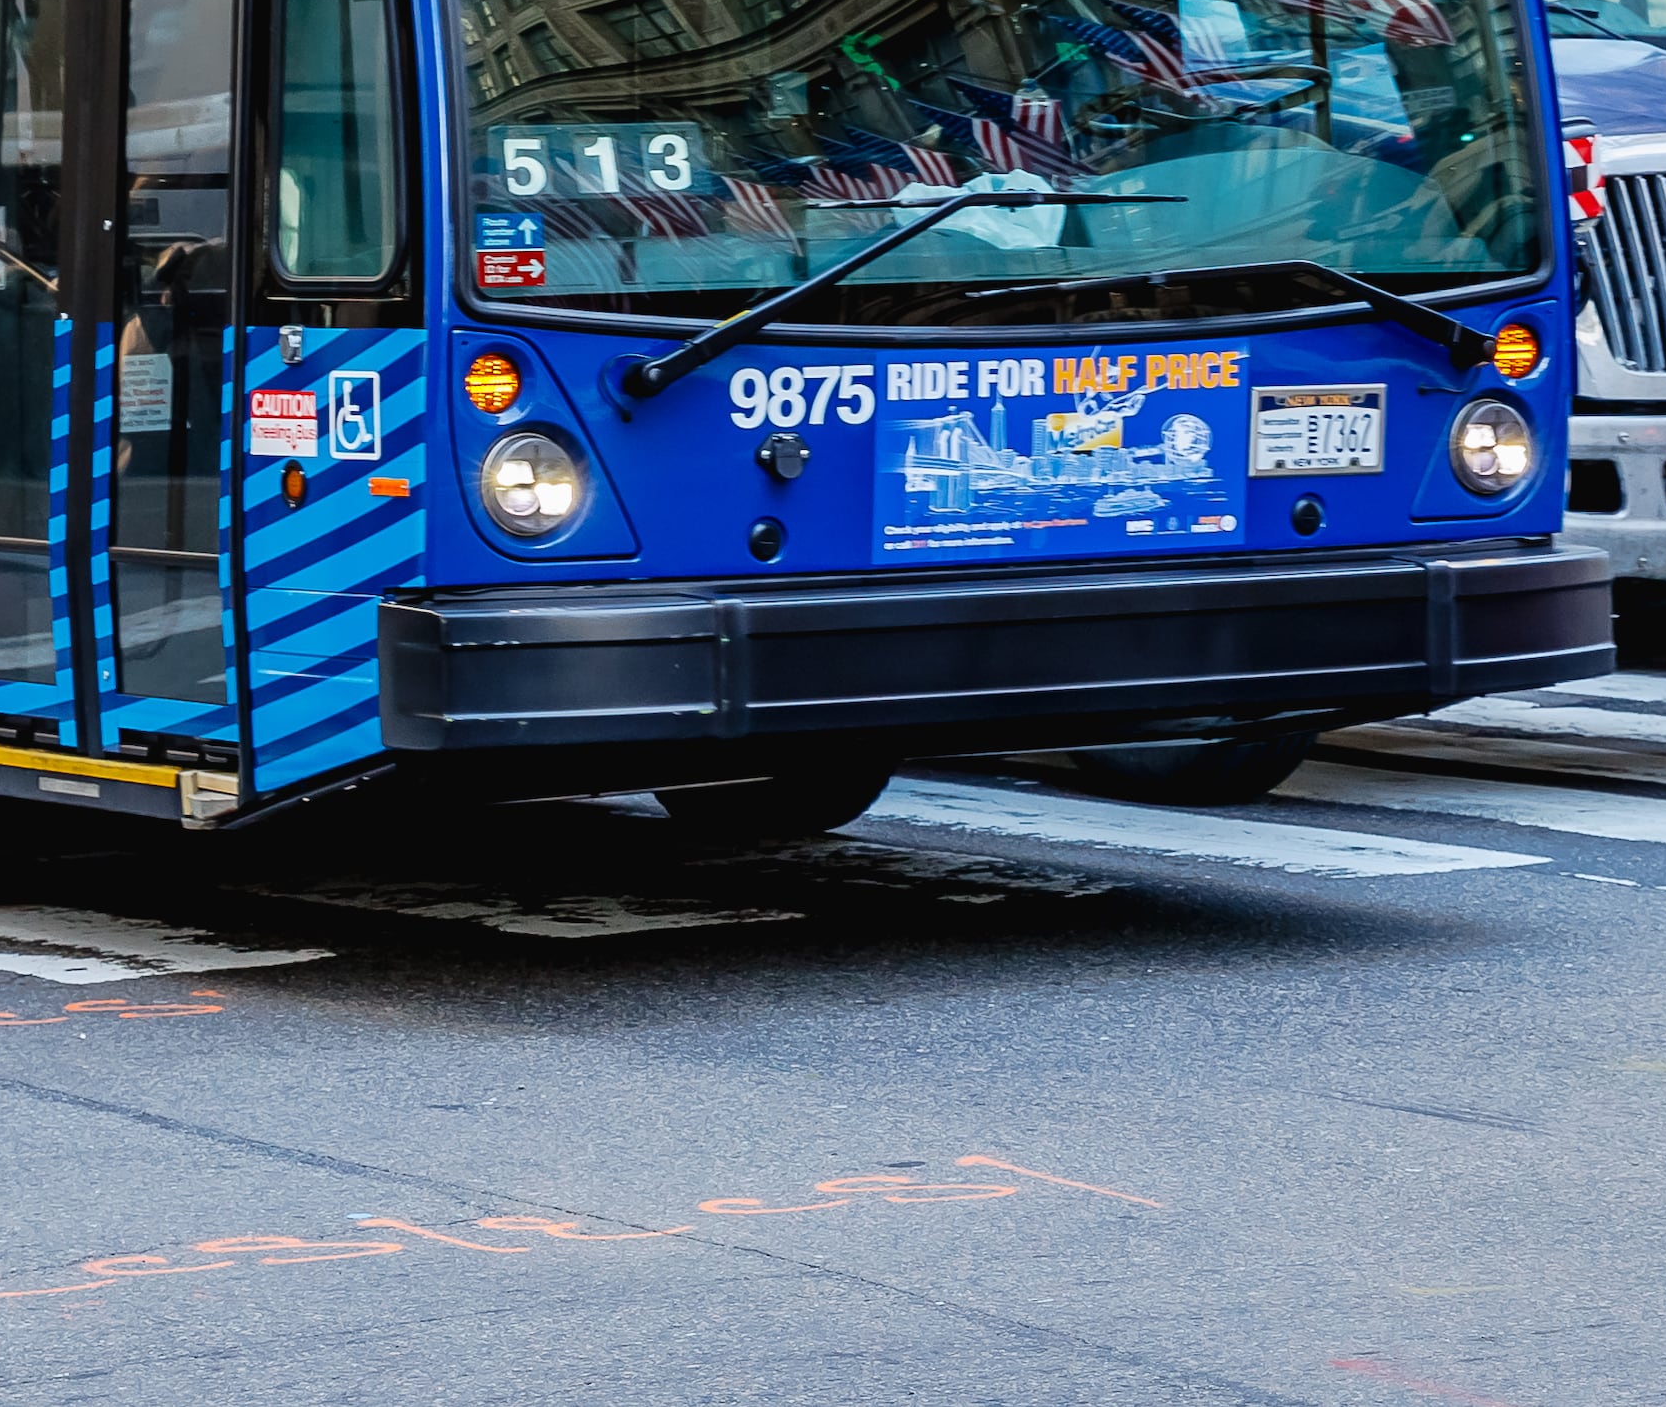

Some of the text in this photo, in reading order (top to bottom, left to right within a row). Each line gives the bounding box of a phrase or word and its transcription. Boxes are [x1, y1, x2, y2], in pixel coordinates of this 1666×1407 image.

[887, 351, 1240, 400] RIDE FOR HALF PRICE
[252, 392, 317, 418] CAUTION
[730, 364, 876, 429] 9875
[296, 423, 317, 441] Bus
[1322, 413, 1373, 454] 7362
